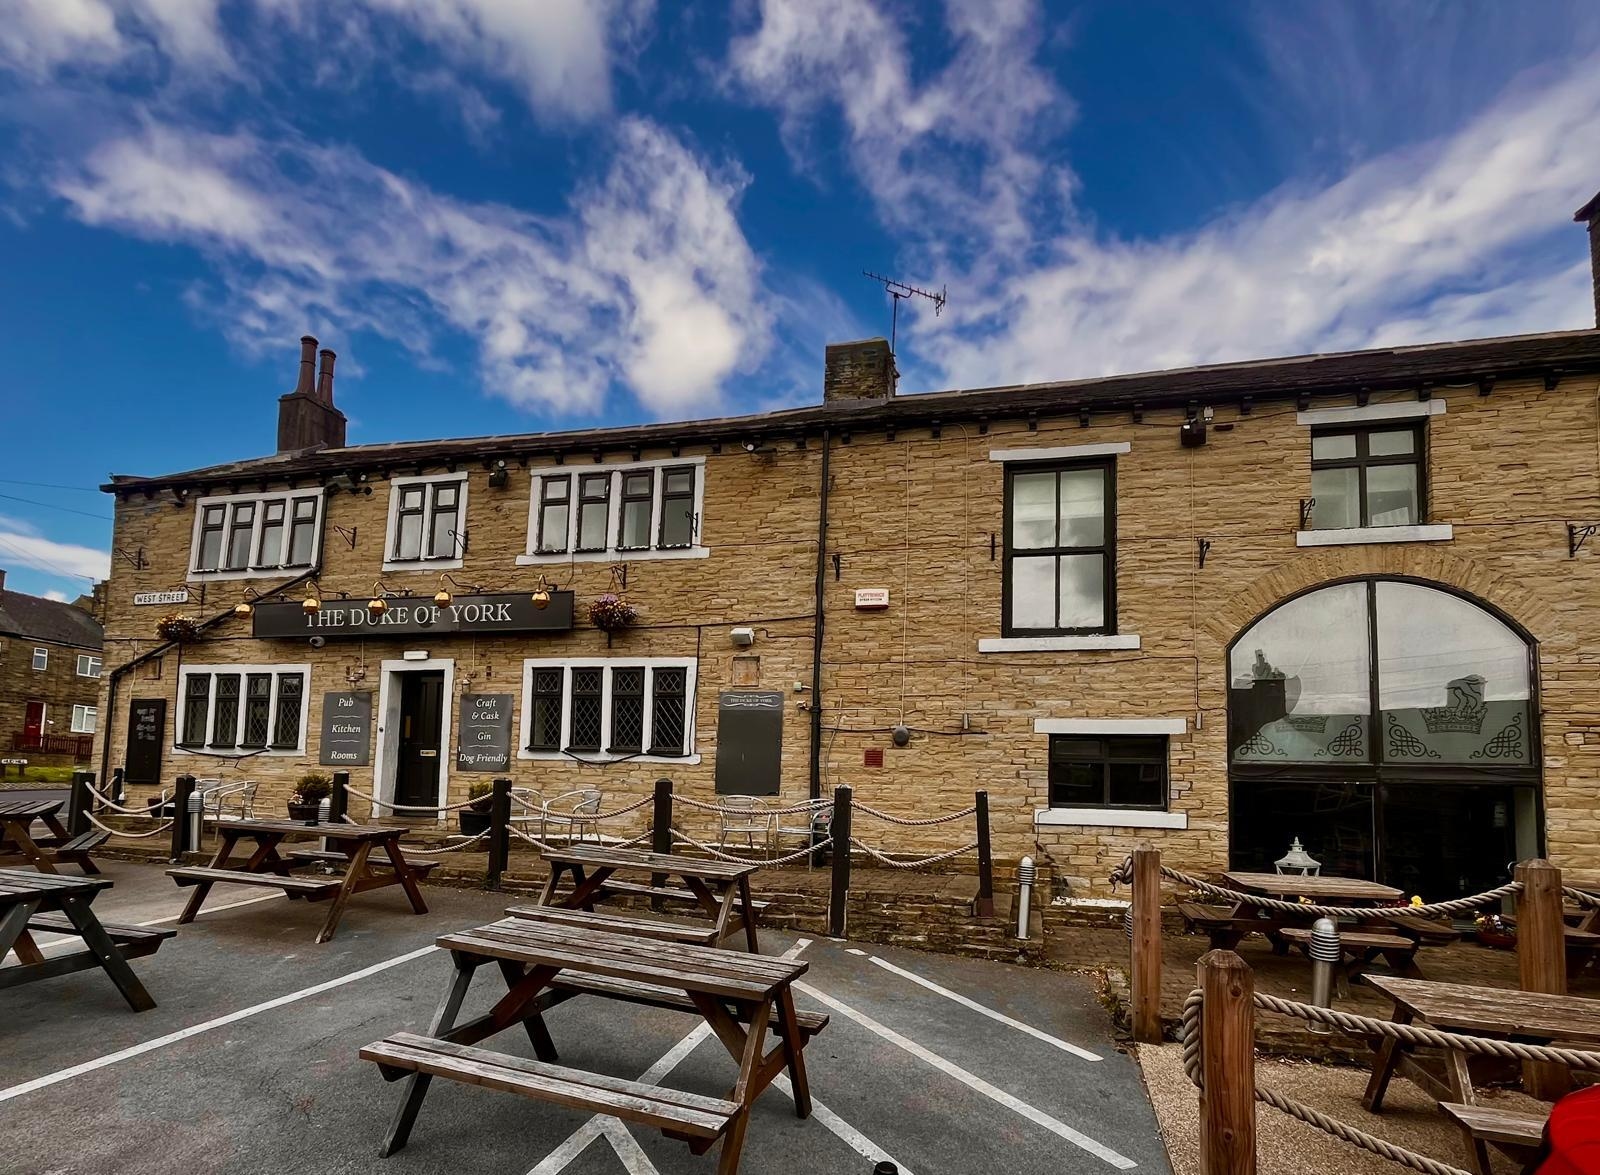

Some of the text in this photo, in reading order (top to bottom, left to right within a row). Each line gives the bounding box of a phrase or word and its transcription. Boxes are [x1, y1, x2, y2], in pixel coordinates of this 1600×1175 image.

[136, 592, 186, 603] WEST STREET
[303, 603, 512, 628] THE DUKE OF YORK
[338, 697, 354, 707] Pub
[476, 698, 497, 710] Craft
[471, 711, 500, 720] & Cask
[331, 723, 361, 733] Kitchen
[477, 731, 491, 740] Gin
[330, 750, 358, 760] Rooms
[459, 753, 508, 765] Dog Friendly
